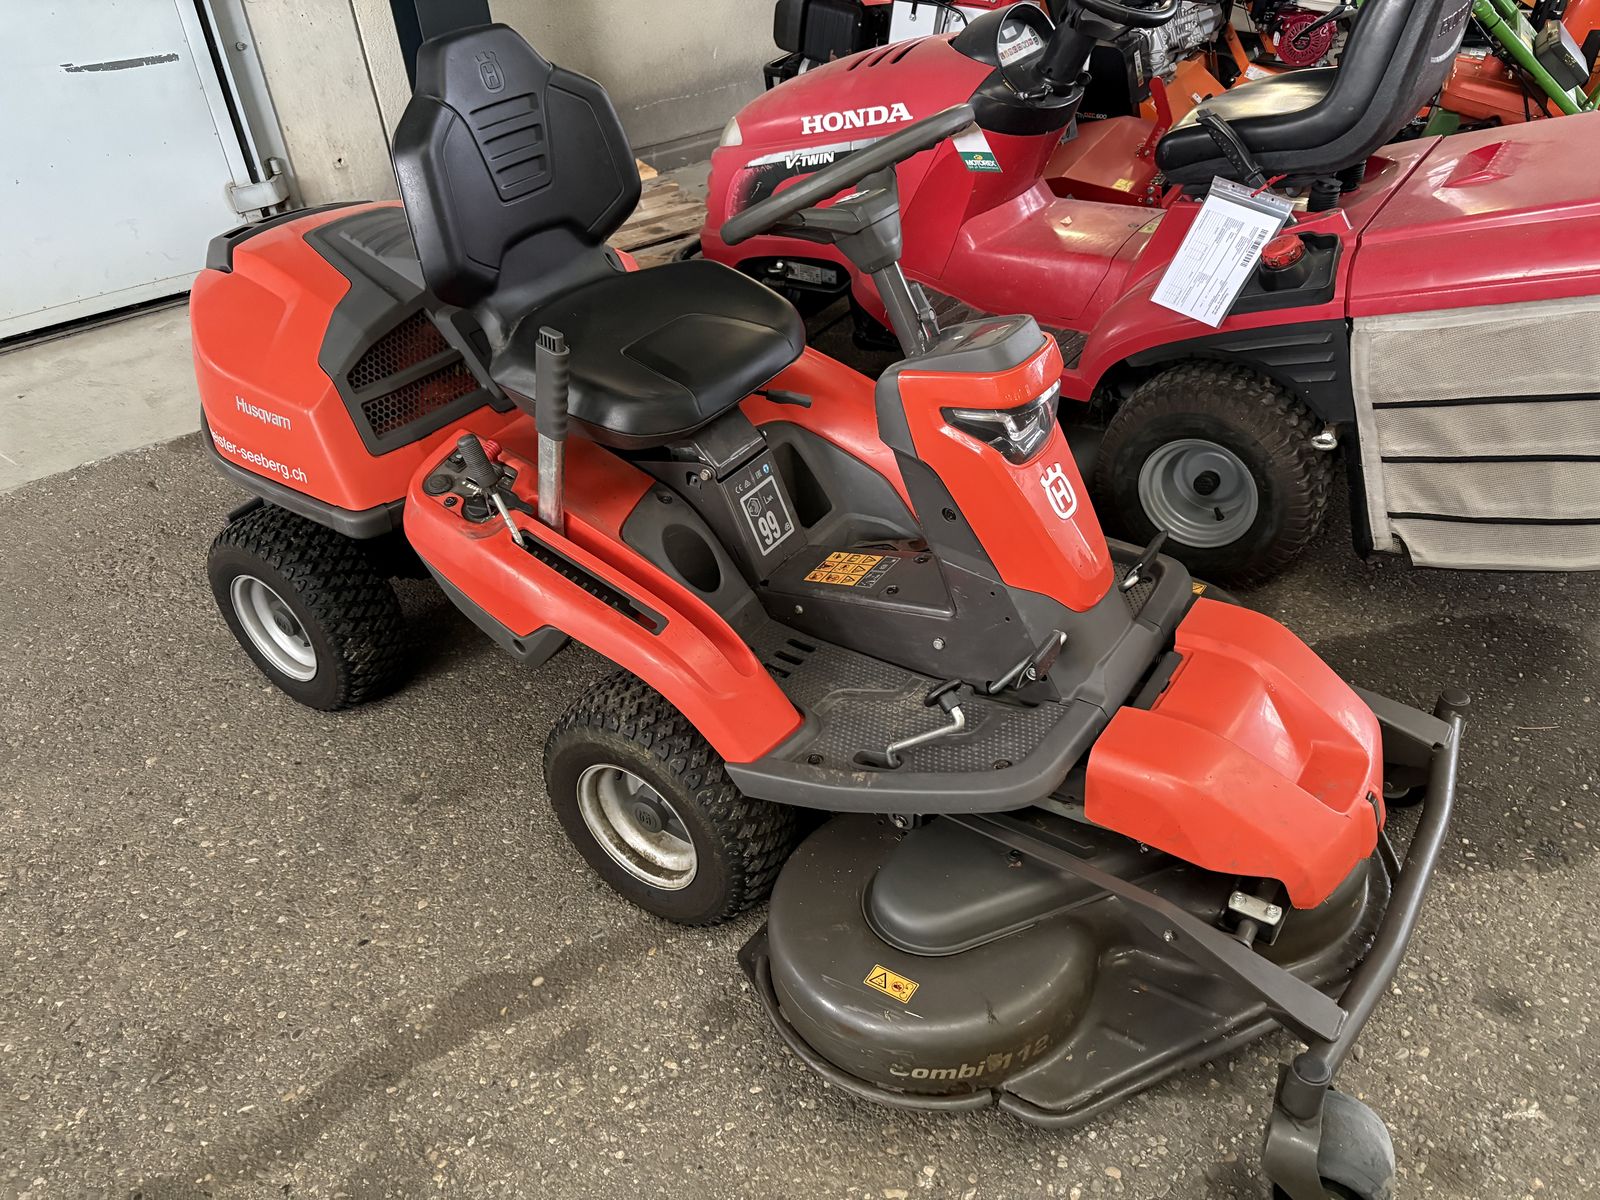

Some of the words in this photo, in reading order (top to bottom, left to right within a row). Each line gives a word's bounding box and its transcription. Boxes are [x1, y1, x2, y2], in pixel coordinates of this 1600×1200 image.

[800, 102, 914, 135] HONDA
[784, 151, 836, 170] V-TWIN
[209, 427, 309, 484] eister-seeberg.ch
[757, 510, 781, 546] 99
